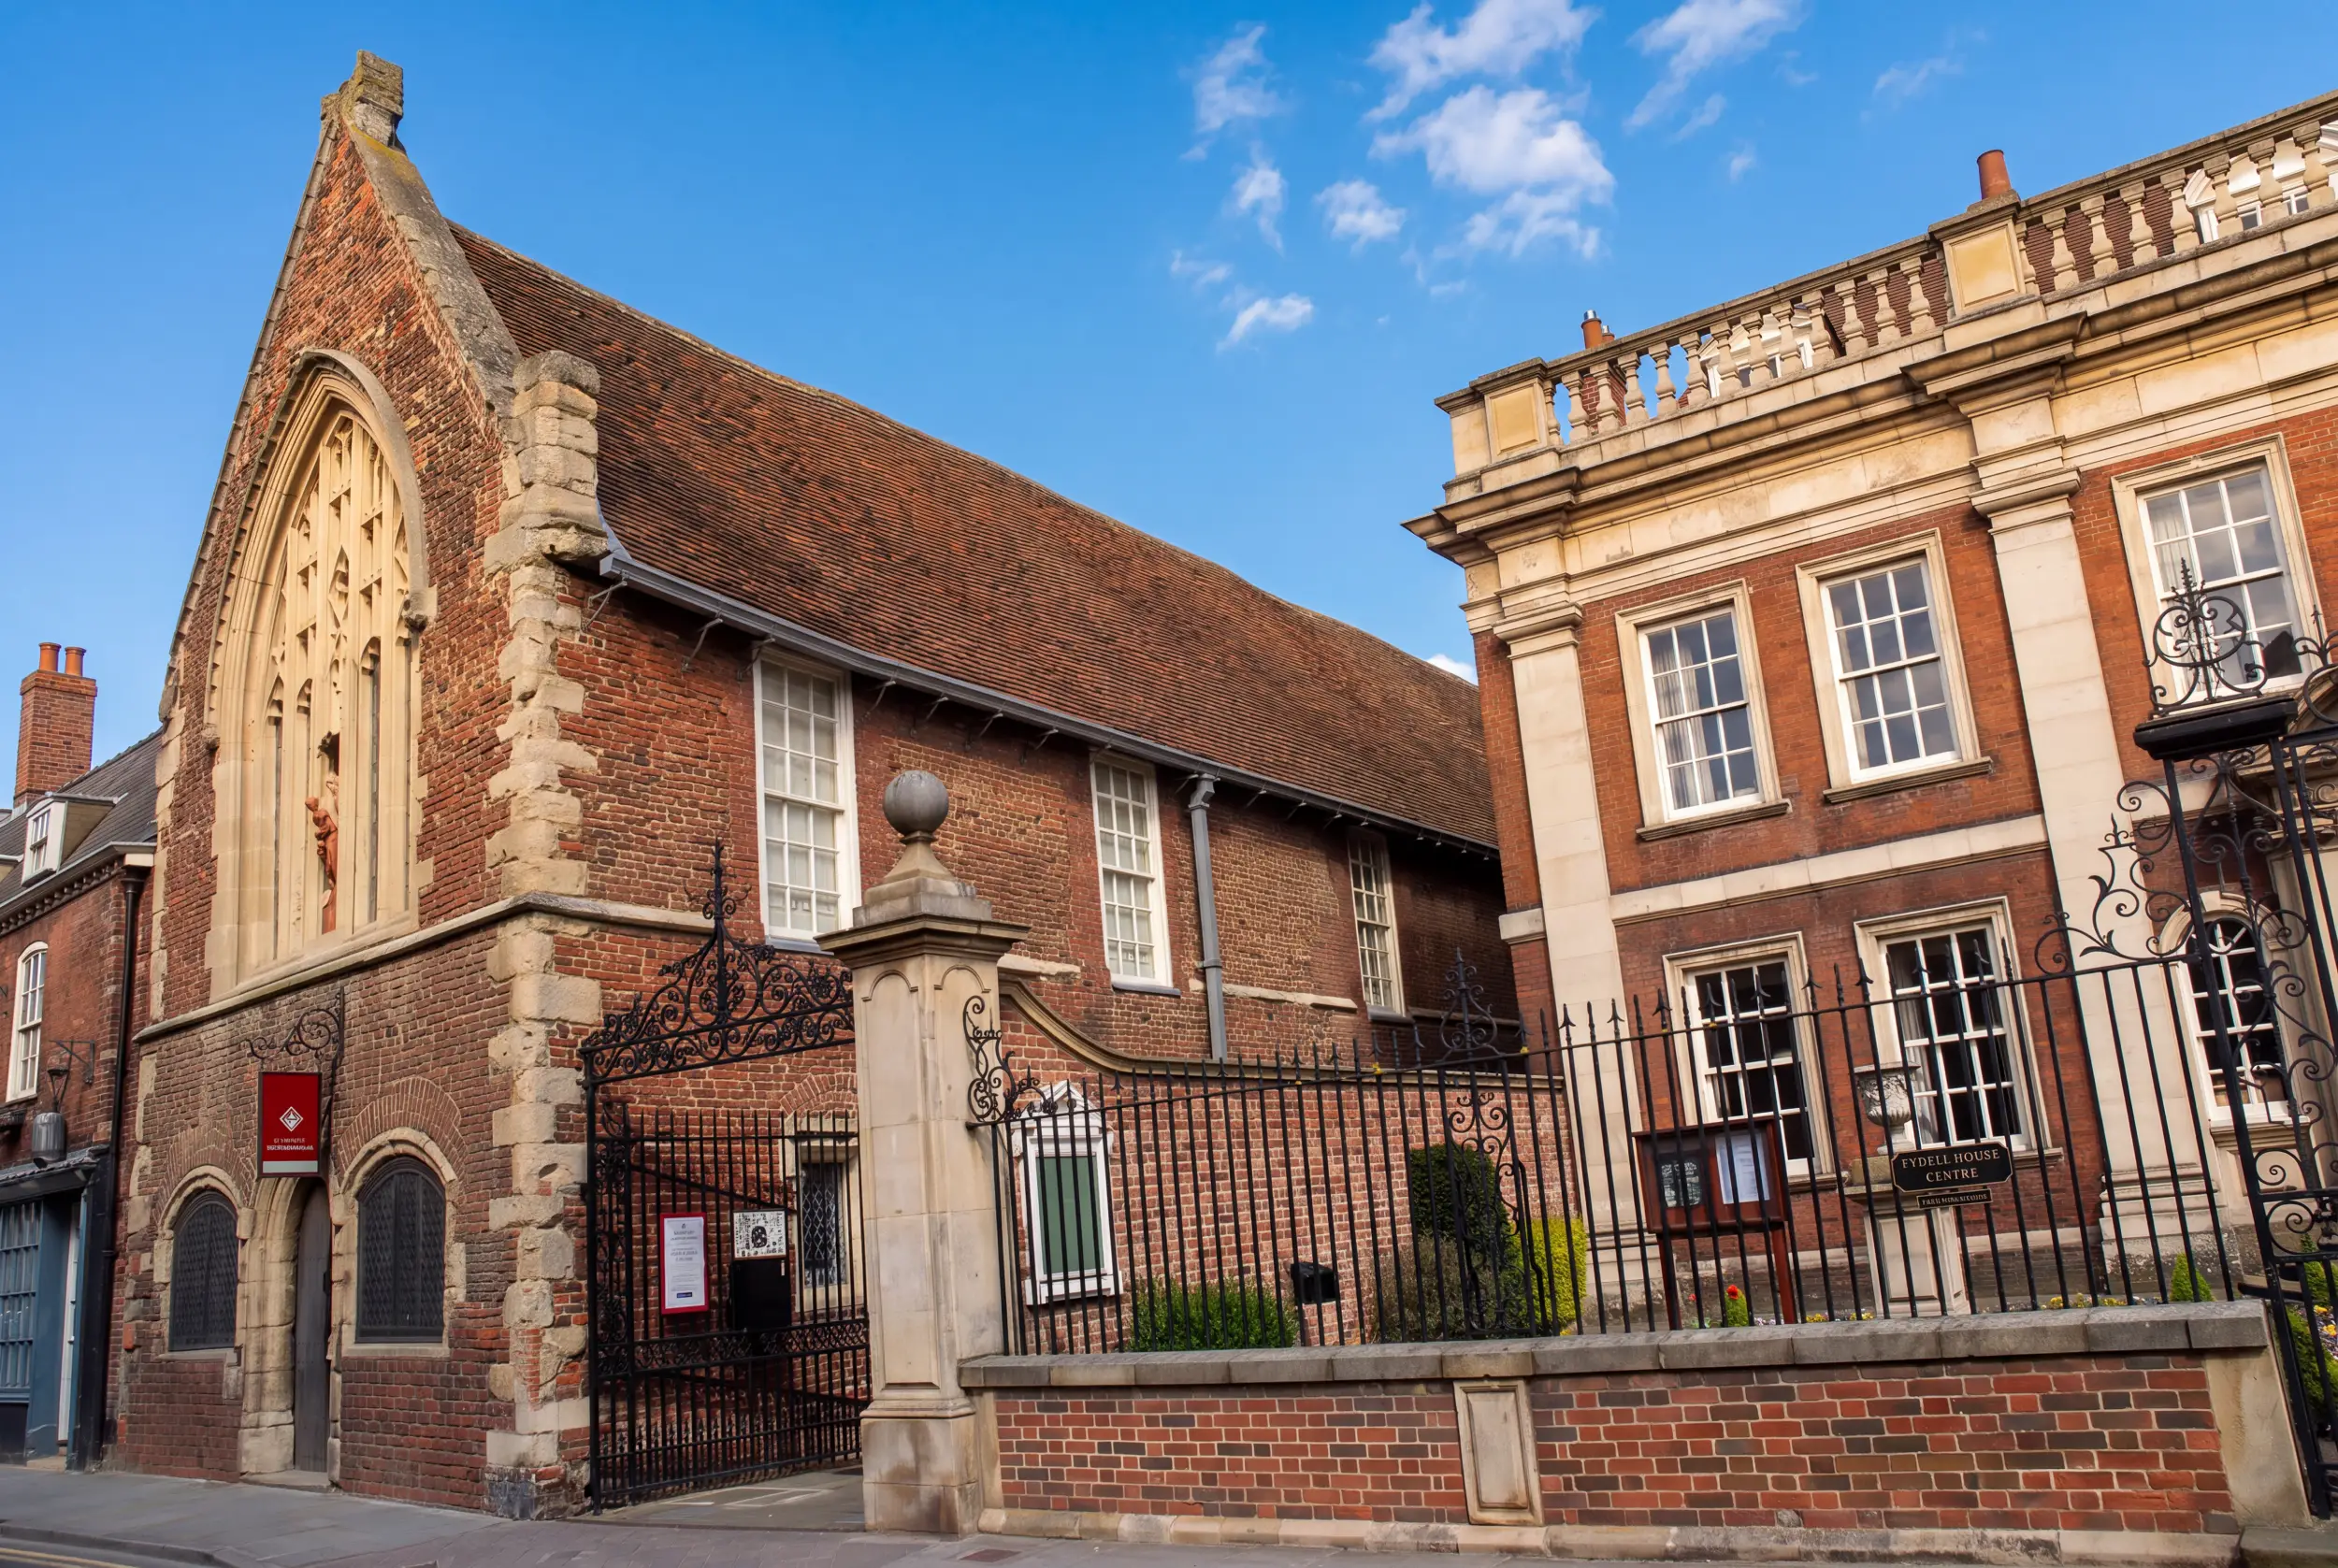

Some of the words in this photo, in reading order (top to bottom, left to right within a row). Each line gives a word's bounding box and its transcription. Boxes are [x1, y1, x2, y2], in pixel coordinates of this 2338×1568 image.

[1902, 1155, 1951, 1169] FYDELL
[1955, 1149, 2000, 1163] HOUSE
[1926, 1168, 1979, 1183] CENTRE
